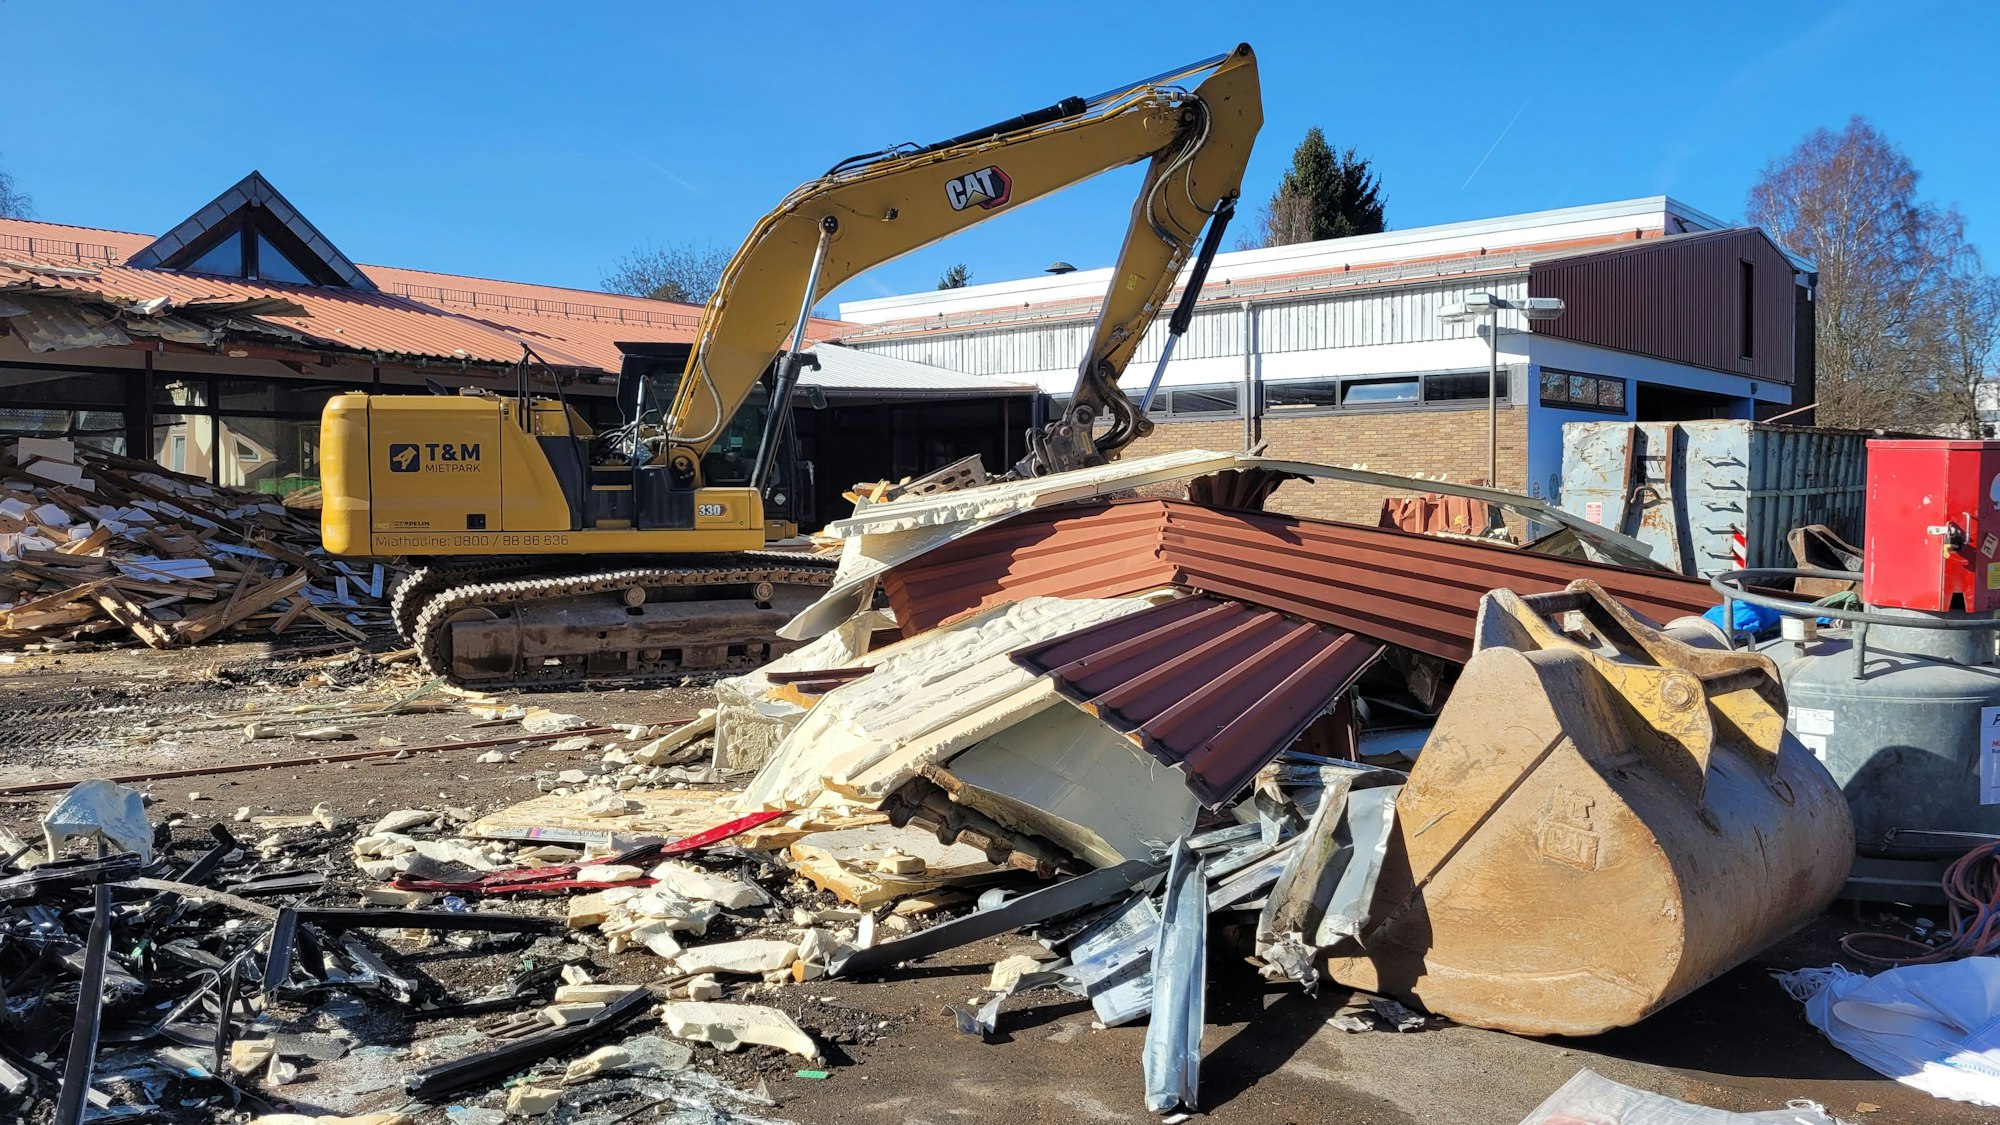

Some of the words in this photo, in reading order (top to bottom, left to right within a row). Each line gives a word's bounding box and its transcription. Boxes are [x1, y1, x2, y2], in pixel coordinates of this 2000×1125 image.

[945, 167, 996, 210] CAT
[425, 443, 480, 461] T&M
[425, 463, 481, 473] MIETPARK
[698, 504, 721, 516] 330
[454, 535, 489, 546] 0800
[503, 535, 520, 546] 88
[523, 535, 540, 546] 86
[544, 534, 569, 546] 636
[1545, 825, 1597, 866] CAT
